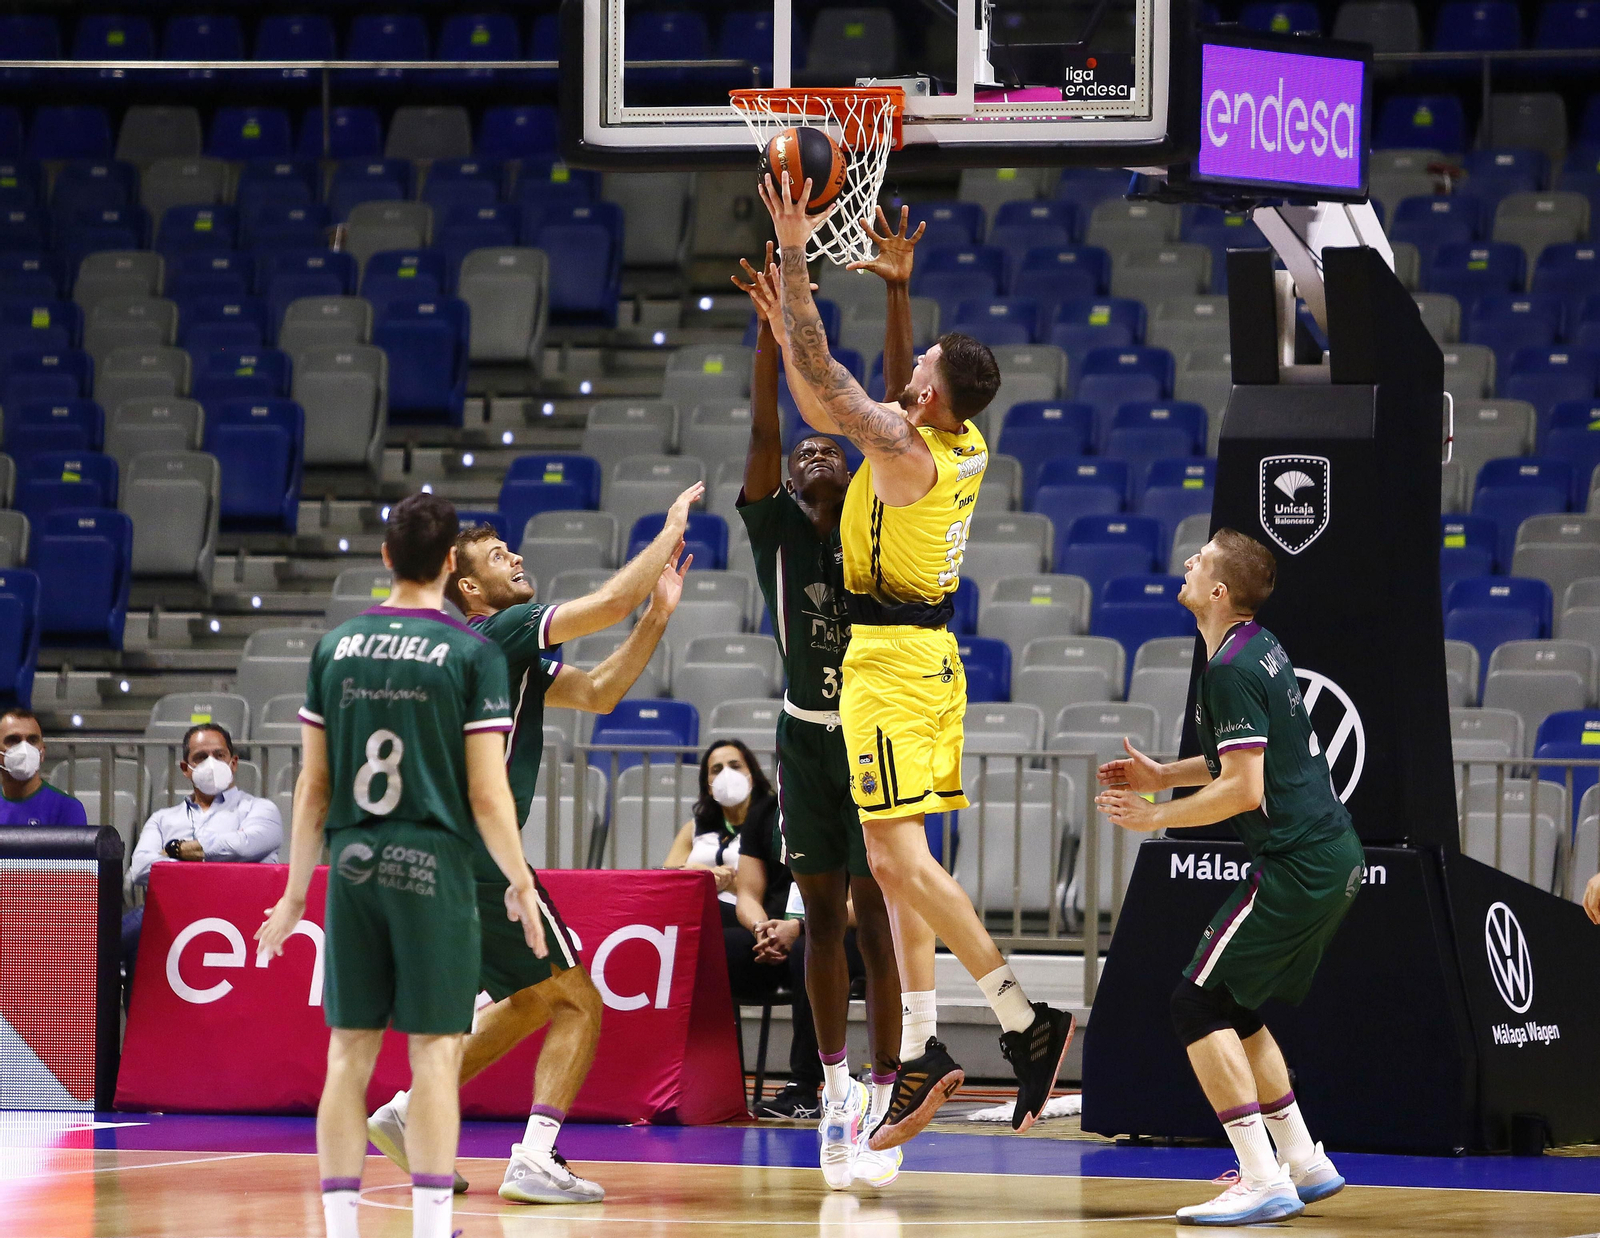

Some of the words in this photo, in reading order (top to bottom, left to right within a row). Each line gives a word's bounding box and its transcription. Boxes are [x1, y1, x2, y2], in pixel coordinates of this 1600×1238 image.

[1065, 66, 1094, 83] liga
[1065, 82, 1128, 96] endesa
[1206, 78, 1355, 159] endesa
[1275, 502, 1314, 516] Unicaja
[1275, 517, 1315, 525] Baloncesto
[333, 633, 450, 667] BRIZUELA
[821, 666, 843, 699] 3
[353, 729, 404, 816] 8
[381, 844, 437, 869] COSTA
[1170, 853, 1252, 880] Mála
[378, 862, 406, 876] DEL
[407, 866, 436, 884] SOL
[1492, 1023, 1528, 1049] Málaga
[1525, 1021, 1561, 1046] Wagen
